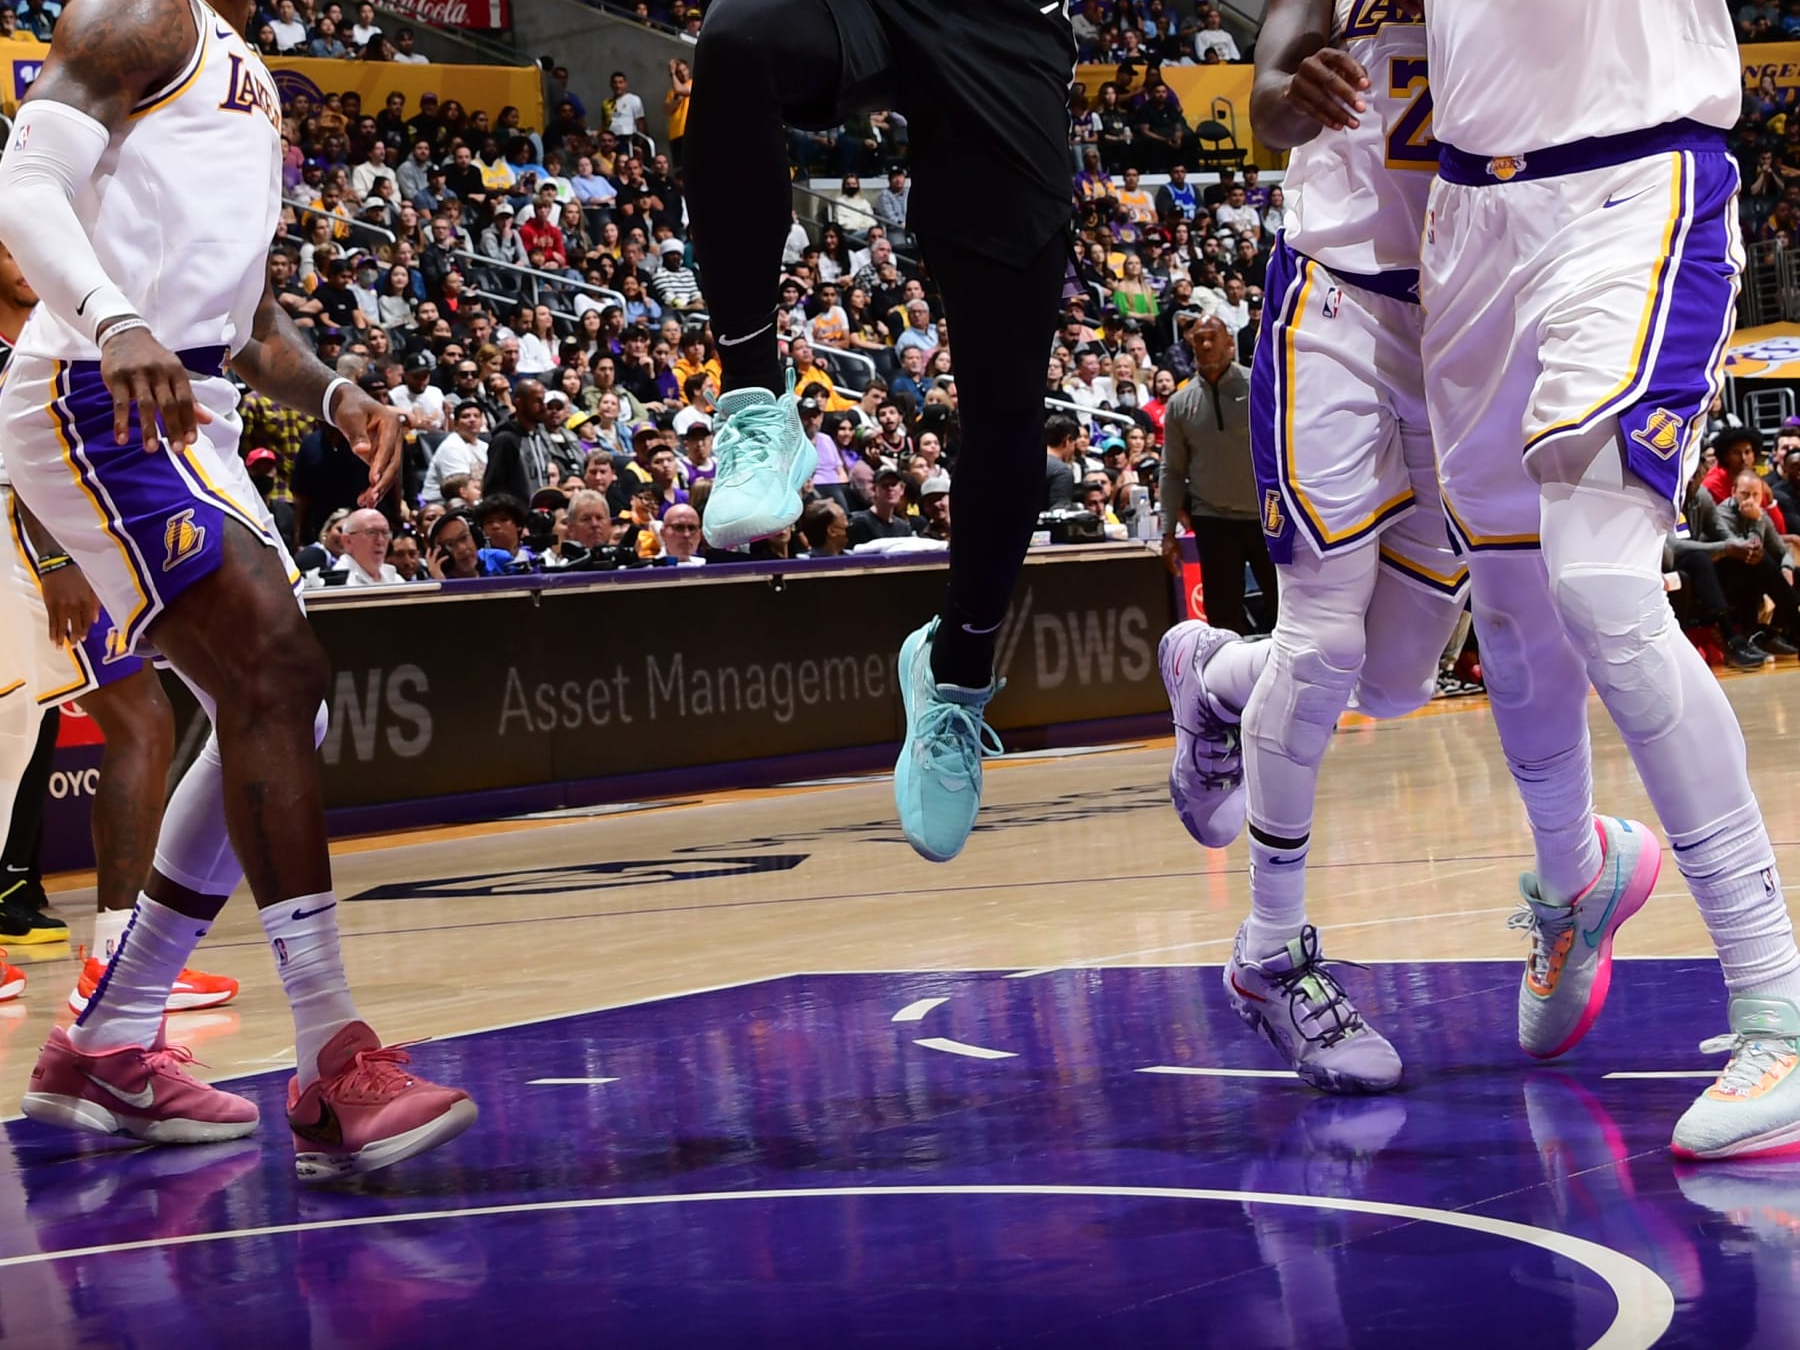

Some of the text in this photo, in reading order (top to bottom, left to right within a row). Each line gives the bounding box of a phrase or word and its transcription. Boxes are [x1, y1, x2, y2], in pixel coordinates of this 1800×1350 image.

[1033, 605, 1151, 690] DWS
[498, 663, 633, 736] Asset
[48, 767, 101, 800] OYO
